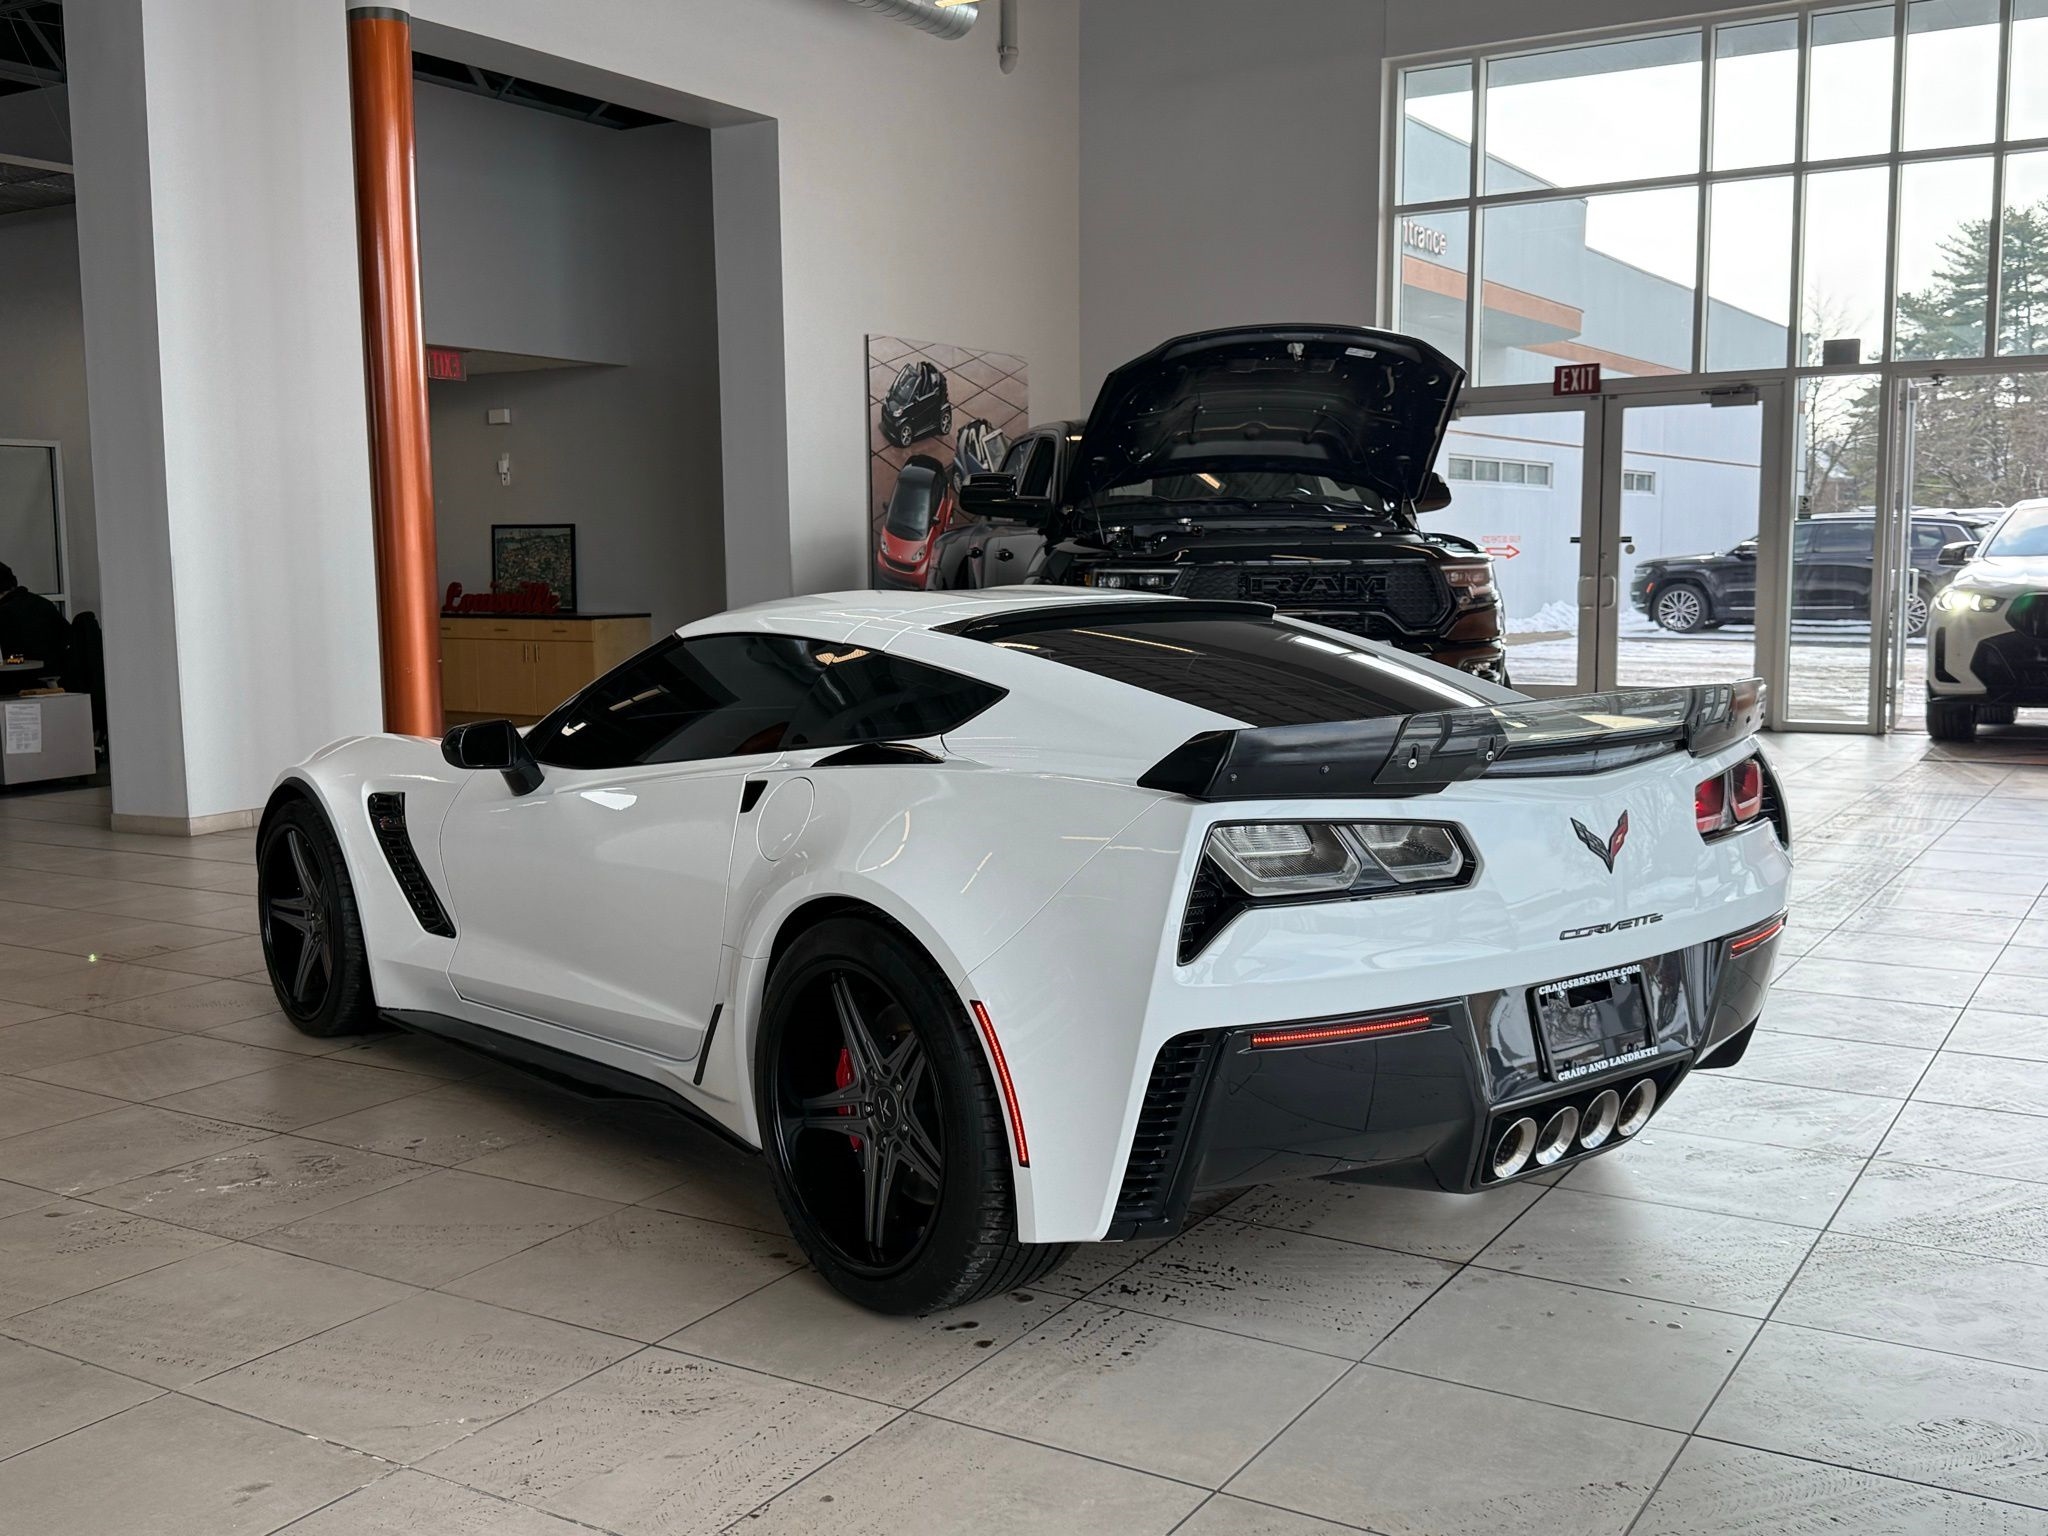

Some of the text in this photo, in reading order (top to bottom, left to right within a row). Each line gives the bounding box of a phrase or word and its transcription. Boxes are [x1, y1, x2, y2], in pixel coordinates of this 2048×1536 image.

[1560, 367, 1595, 391] EXIT
[1250, 576, 1388, 594] RAM
[1559, 912, 1663, 941] CORVETTE
[1539, 964, 1641, 995] CRAIGSBESTCARS.COM
[1558, 1046, 1659, 1081] CRAIG AND LANDRETH
